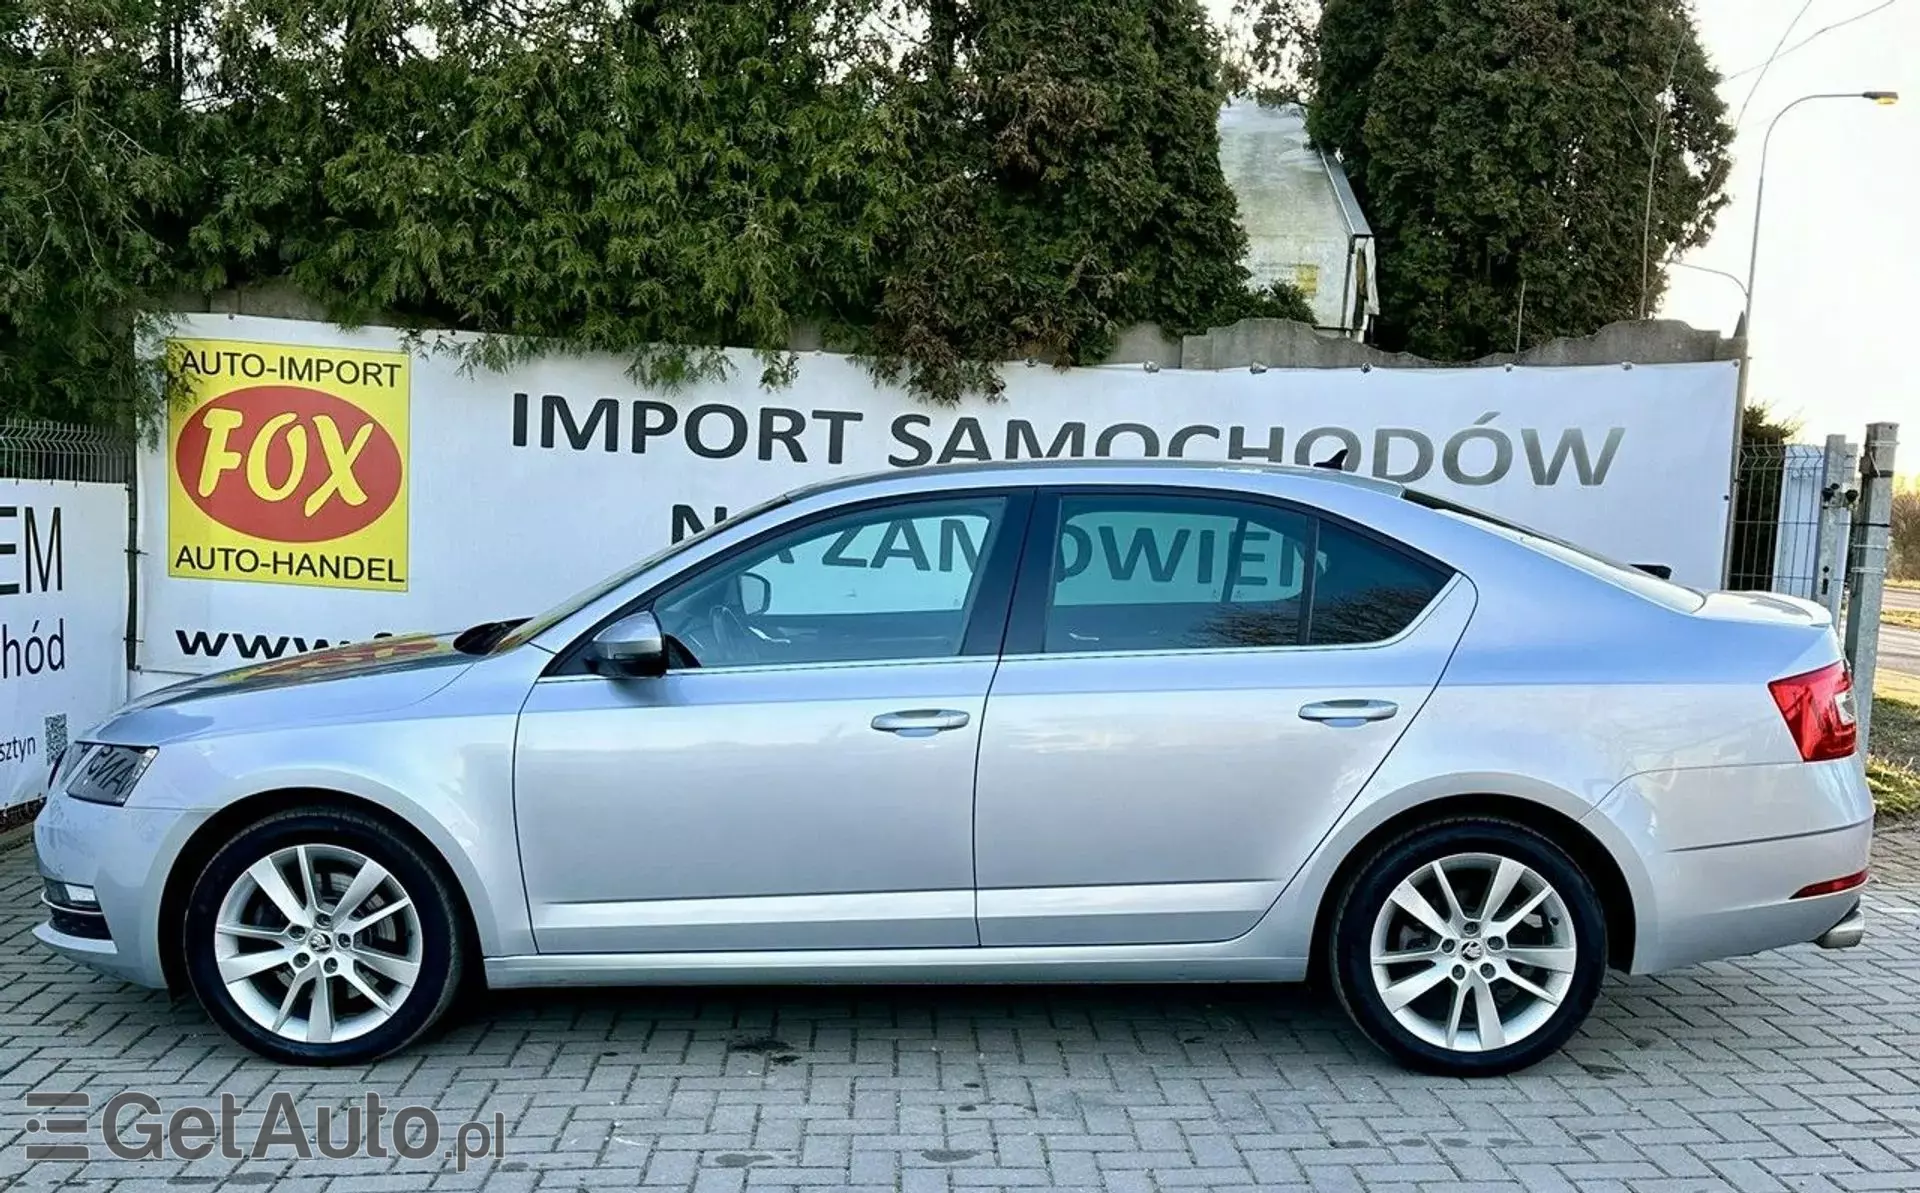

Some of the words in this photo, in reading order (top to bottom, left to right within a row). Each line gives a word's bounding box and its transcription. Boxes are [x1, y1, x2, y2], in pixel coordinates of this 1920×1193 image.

[180, 350, 401, 387] AUTO-IMPORT
[198, 408, 374, 517] FOX
[512, 392, 863, 465] IMPORT
[888, 411, 1626, 486] SAMOCHODÓW
[175, 545, 405, 583] AUTO-HANDEL
[2, 618, 65, 679] hód
